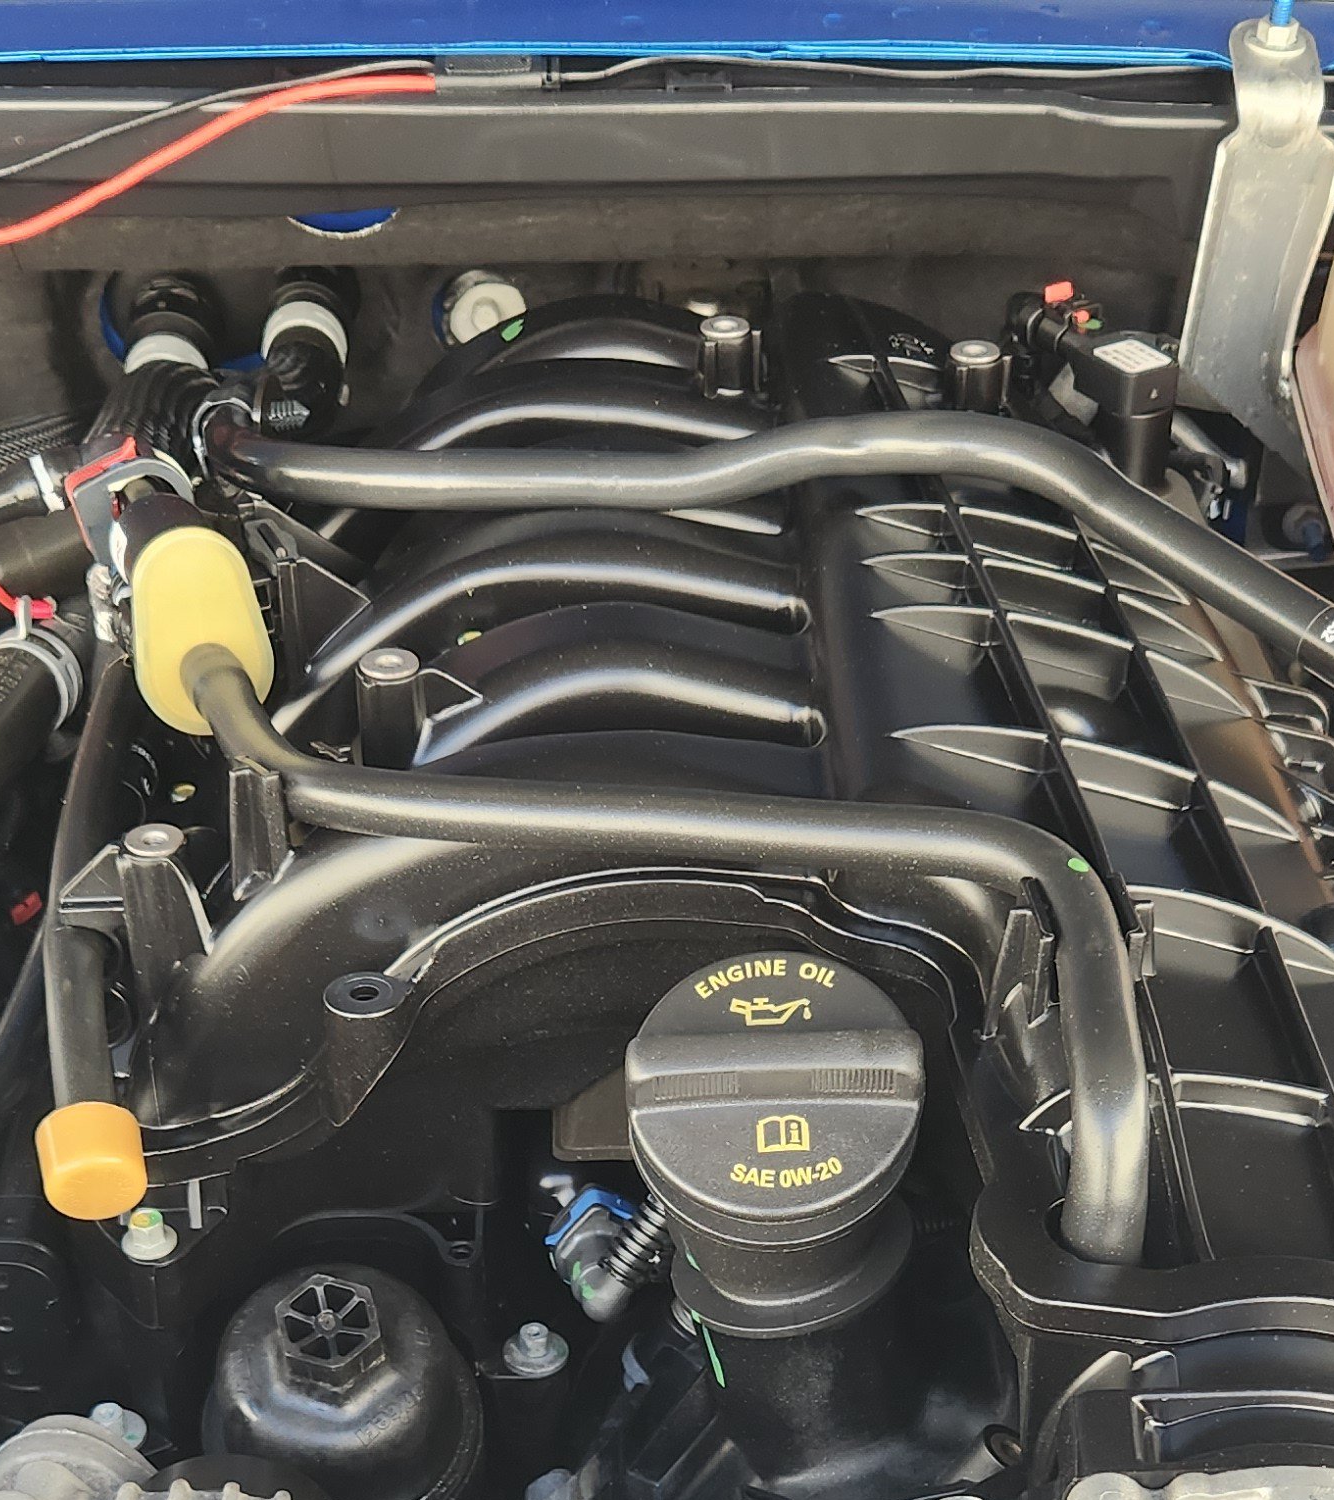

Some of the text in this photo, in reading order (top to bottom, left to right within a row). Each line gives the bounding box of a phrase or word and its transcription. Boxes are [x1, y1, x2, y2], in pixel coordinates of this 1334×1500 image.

[694, 959, 836, 999] ENGINE OIL
[730, 1157, 843, 1188] SAE 0W-20
